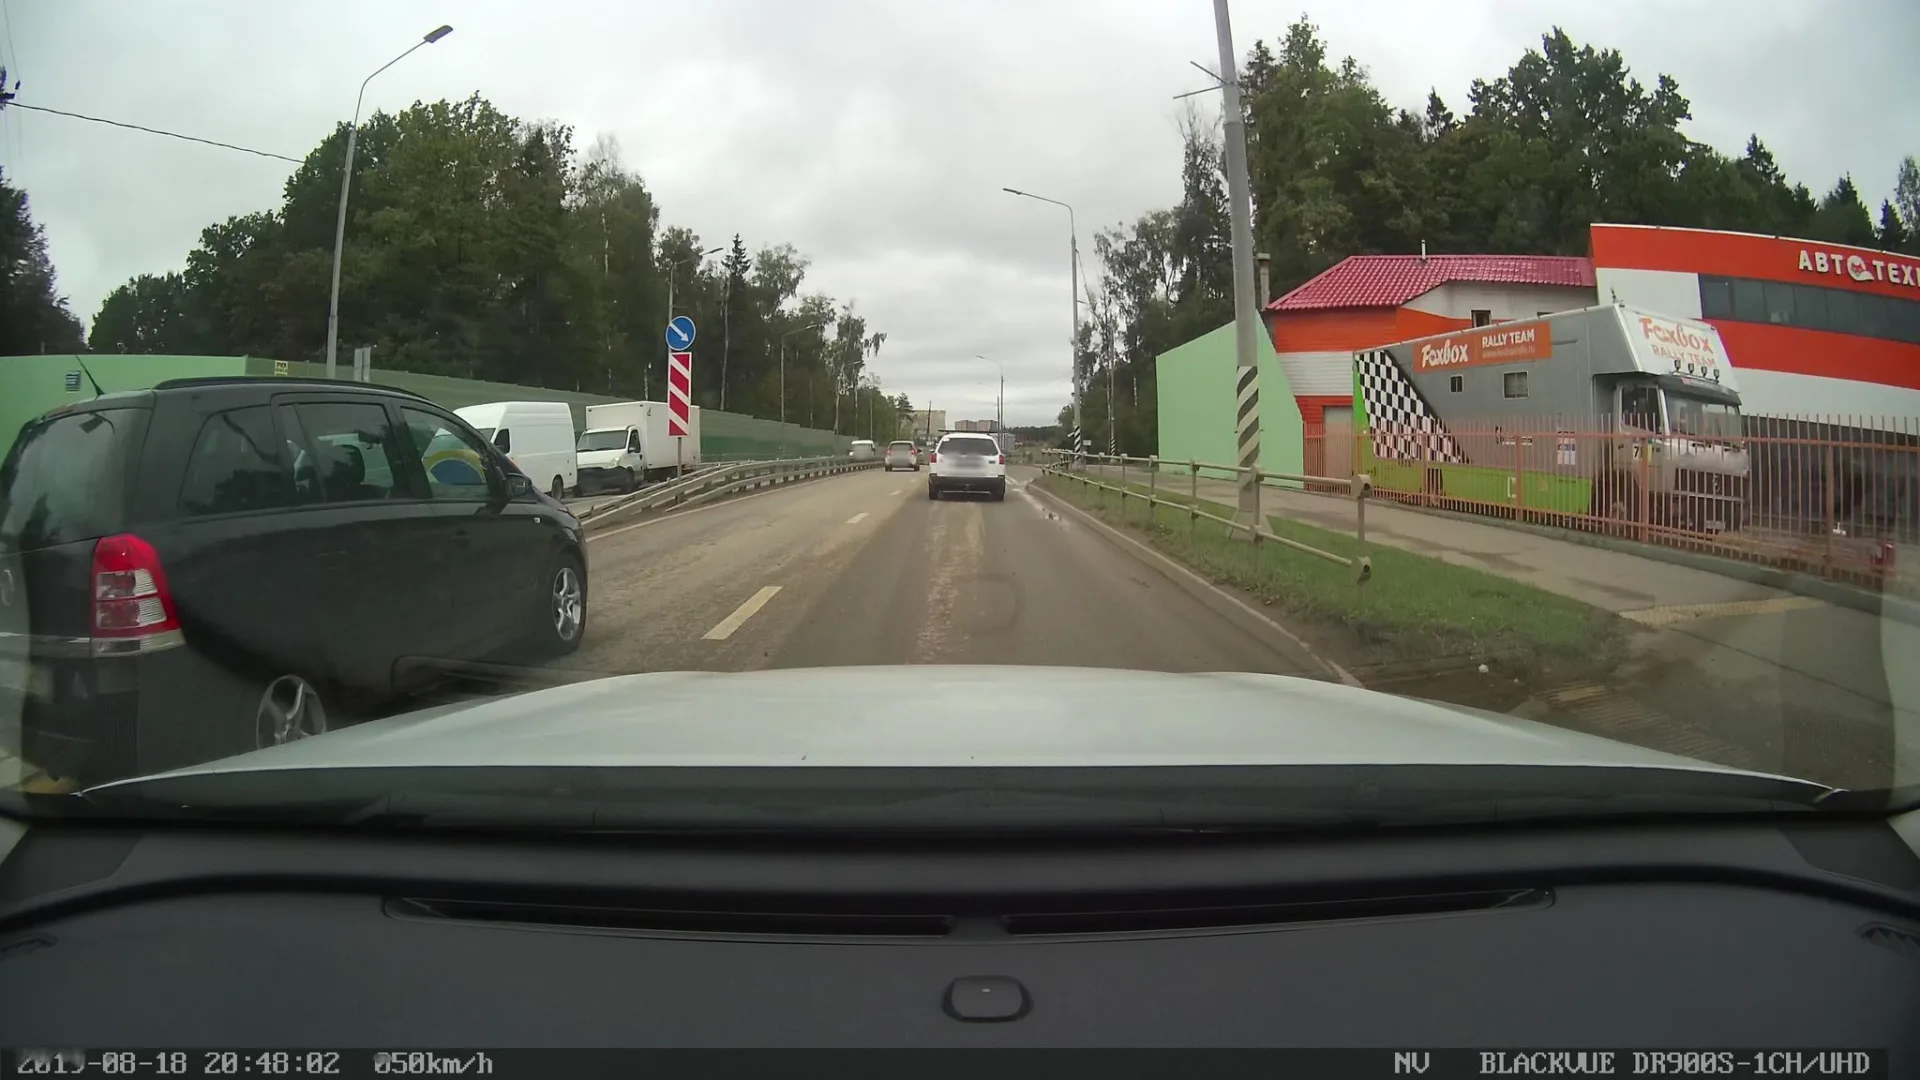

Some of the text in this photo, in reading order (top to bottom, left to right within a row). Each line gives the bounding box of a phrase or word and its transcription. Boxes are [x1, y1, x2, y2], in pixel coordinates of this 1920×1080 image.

[1798, 249, 1920, 287] АВТОТЕХ
[1482, 329, 1535, 348] RALLY TEAM
[1651, 344, 1717, 367] RALLY TEAM
